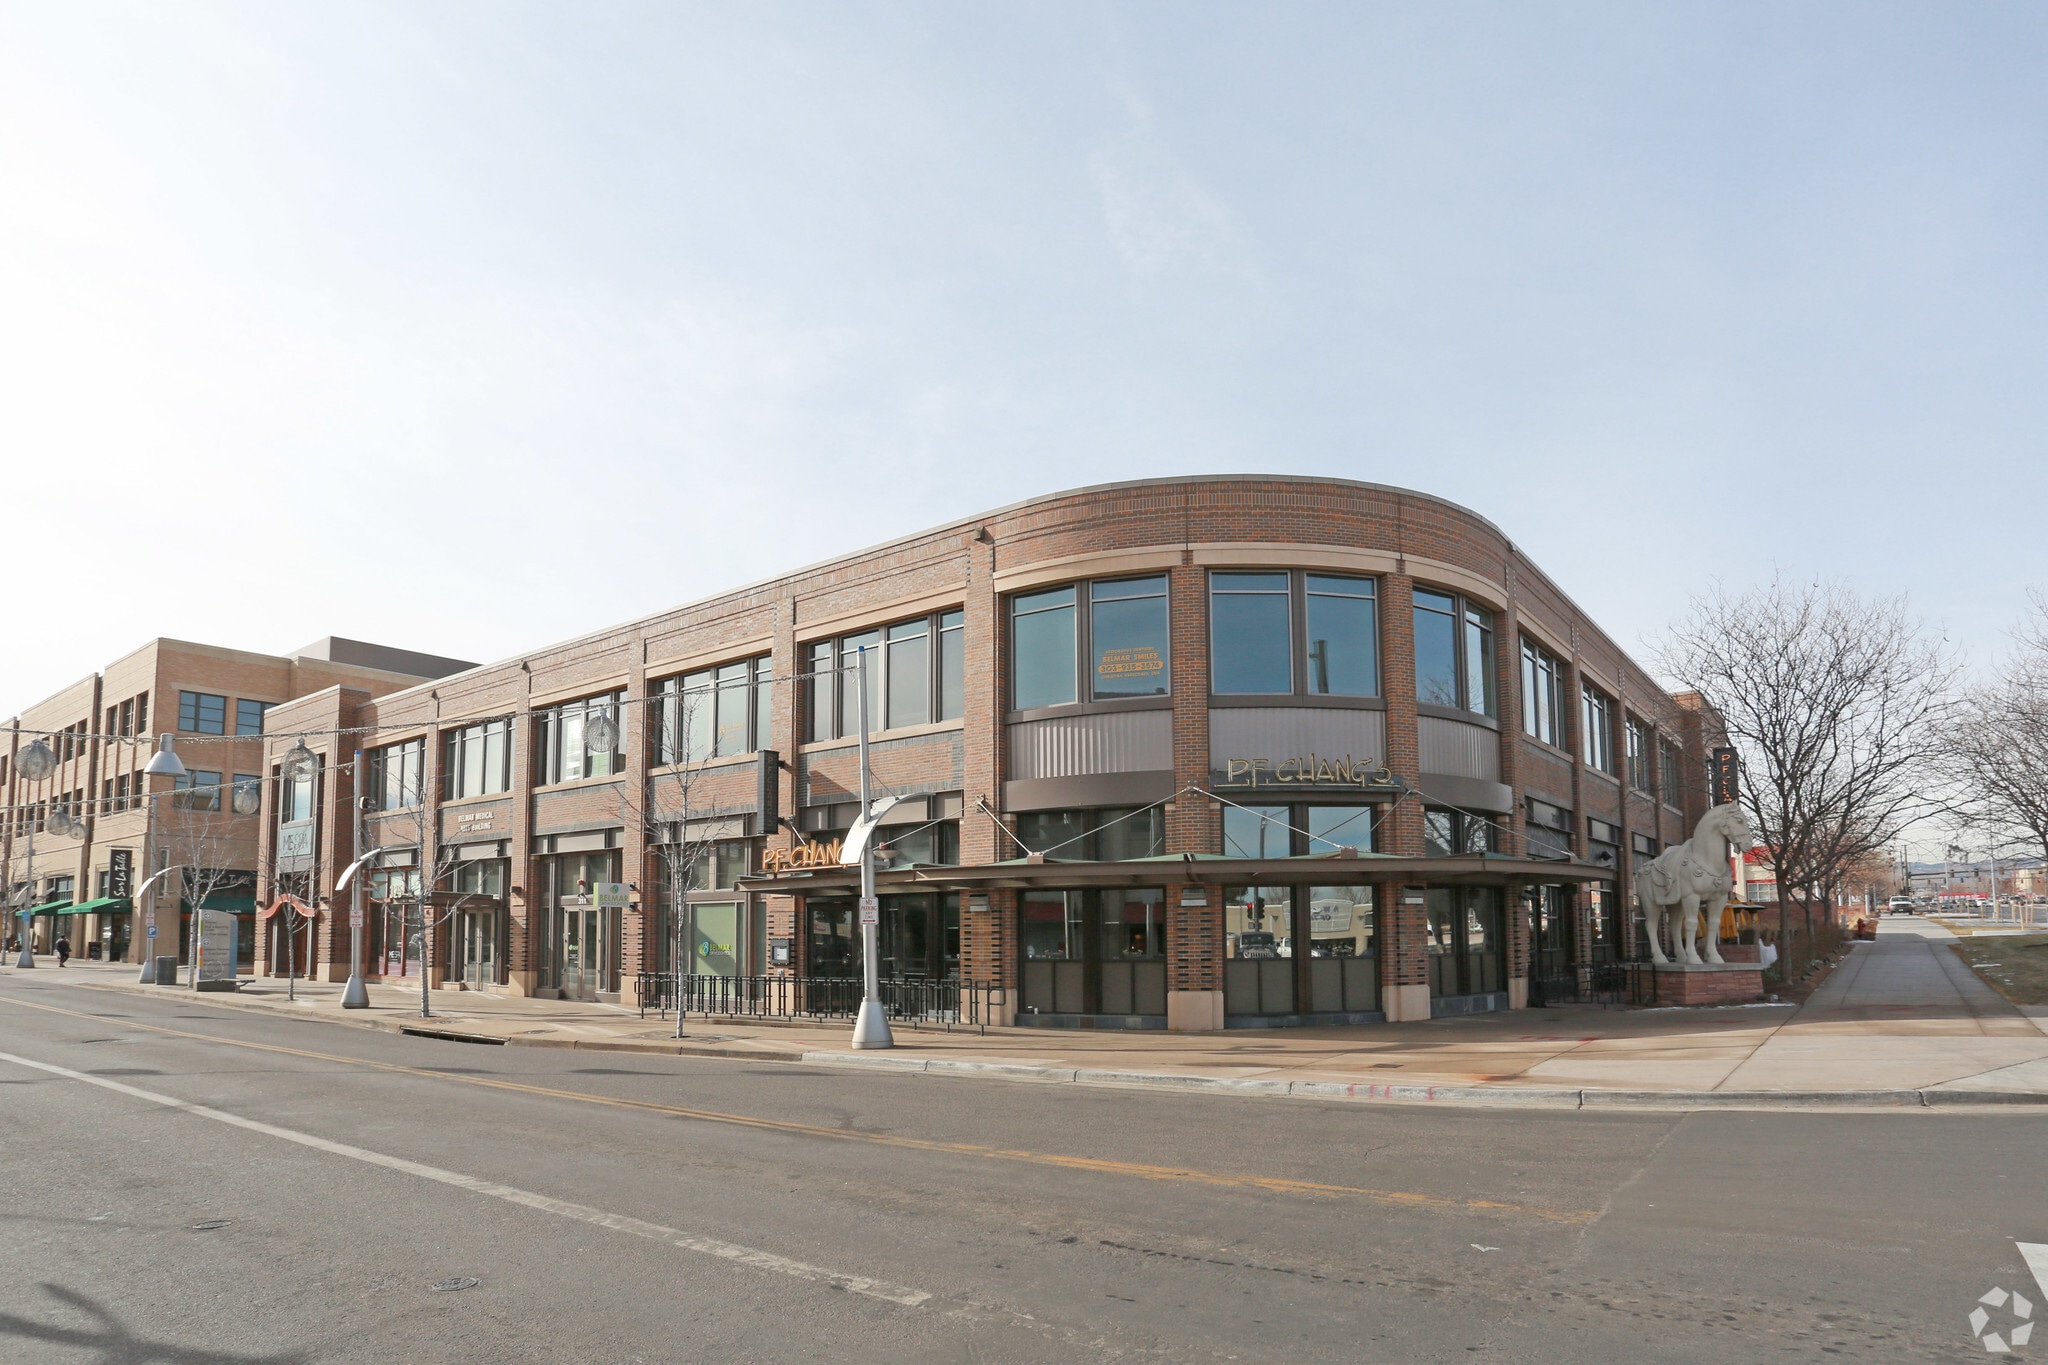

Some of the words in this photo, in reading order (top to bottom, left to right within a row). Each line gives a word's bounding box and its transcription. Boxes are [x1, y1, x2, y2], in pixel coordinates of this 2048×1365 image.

[1102, 654, 1131, 663] BELMAR
[1133, 652, 1159, 661] SMILES
[1100, 661, 1160, 673] 303-935-3574
[1275, 752, 1393, 788] CHANG'S
[113, 881, 126, 897] Sur
[578, 897, 587, 905] 311
[600, 894, 629, 902] BELMAR
